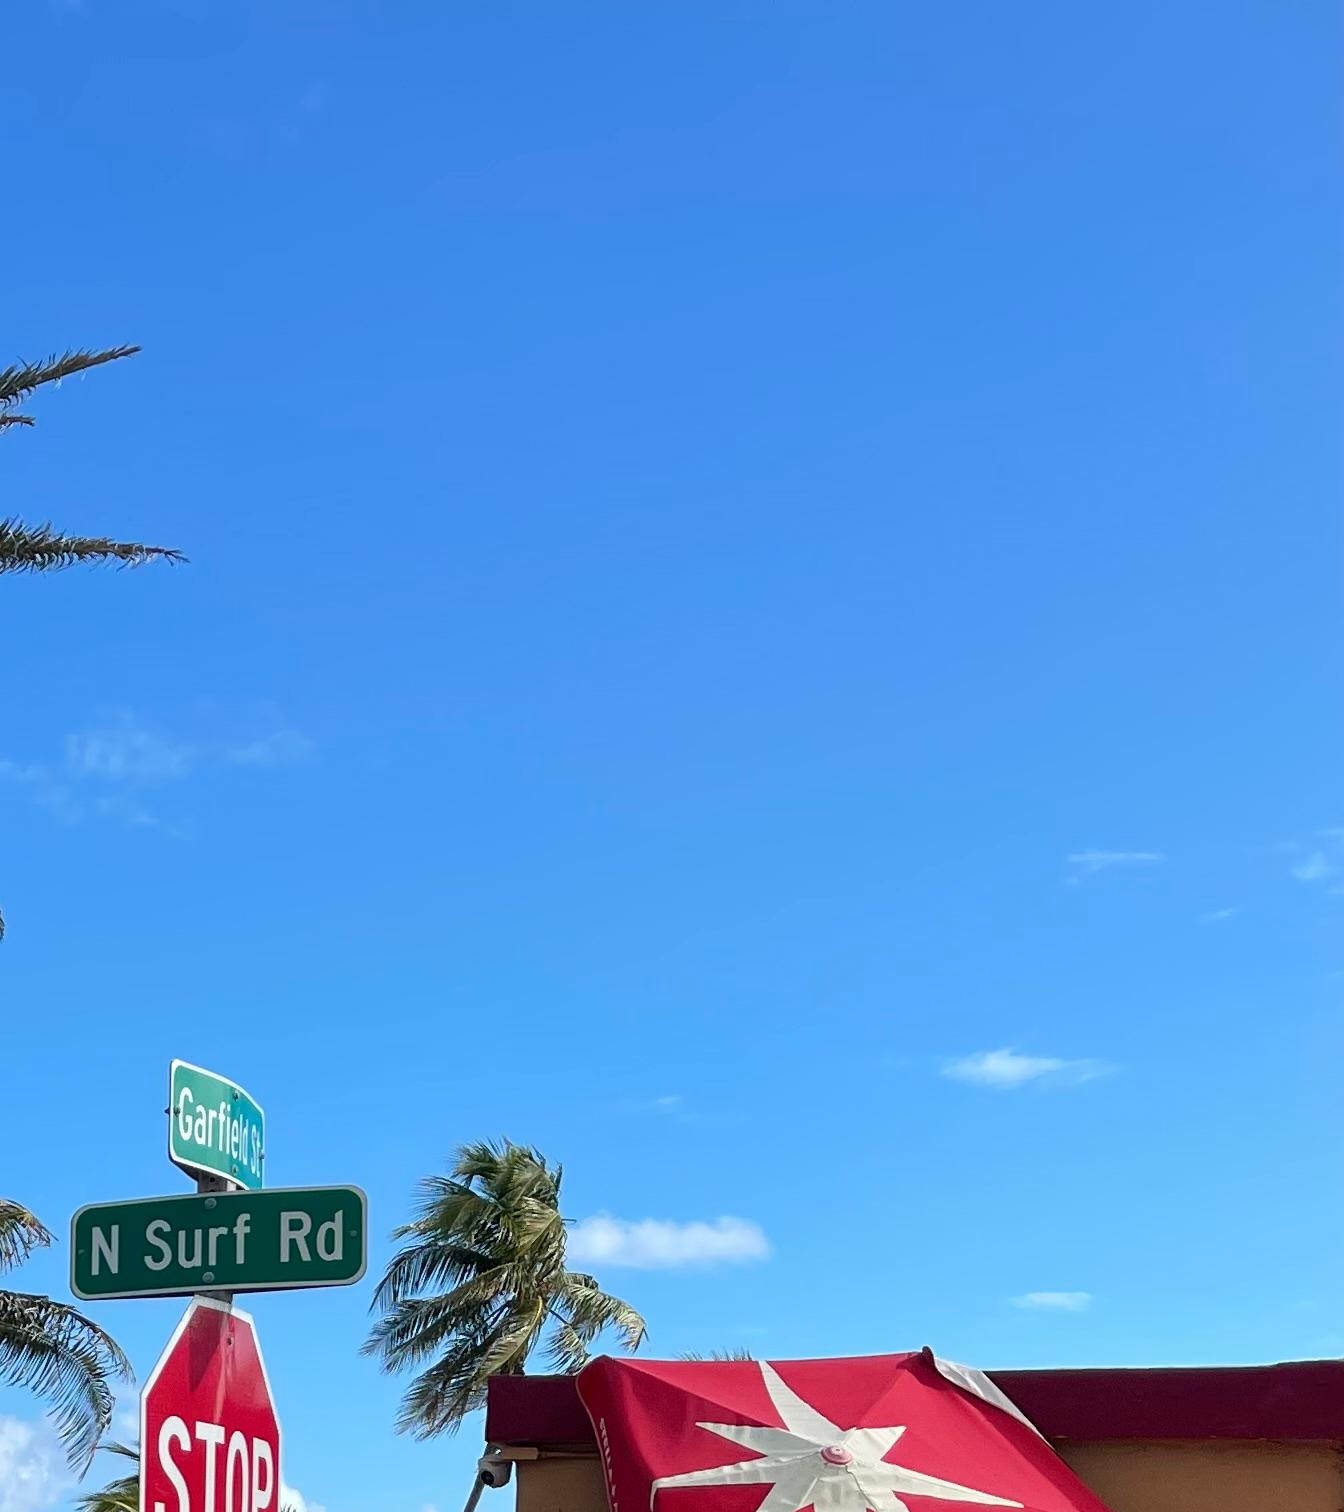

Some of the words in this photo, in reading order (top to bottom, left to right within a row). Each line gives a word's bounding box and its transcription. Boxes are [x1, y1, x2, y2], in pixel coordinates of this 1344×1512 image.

[178, 1087, 249, 1166] Garfield
[251, 1124, 261, 1178] St
[91, 1225, 119, 1276] N
[144, 1213, 250, 1271] Surf
[280, 1210, 343, 1263] Rd
